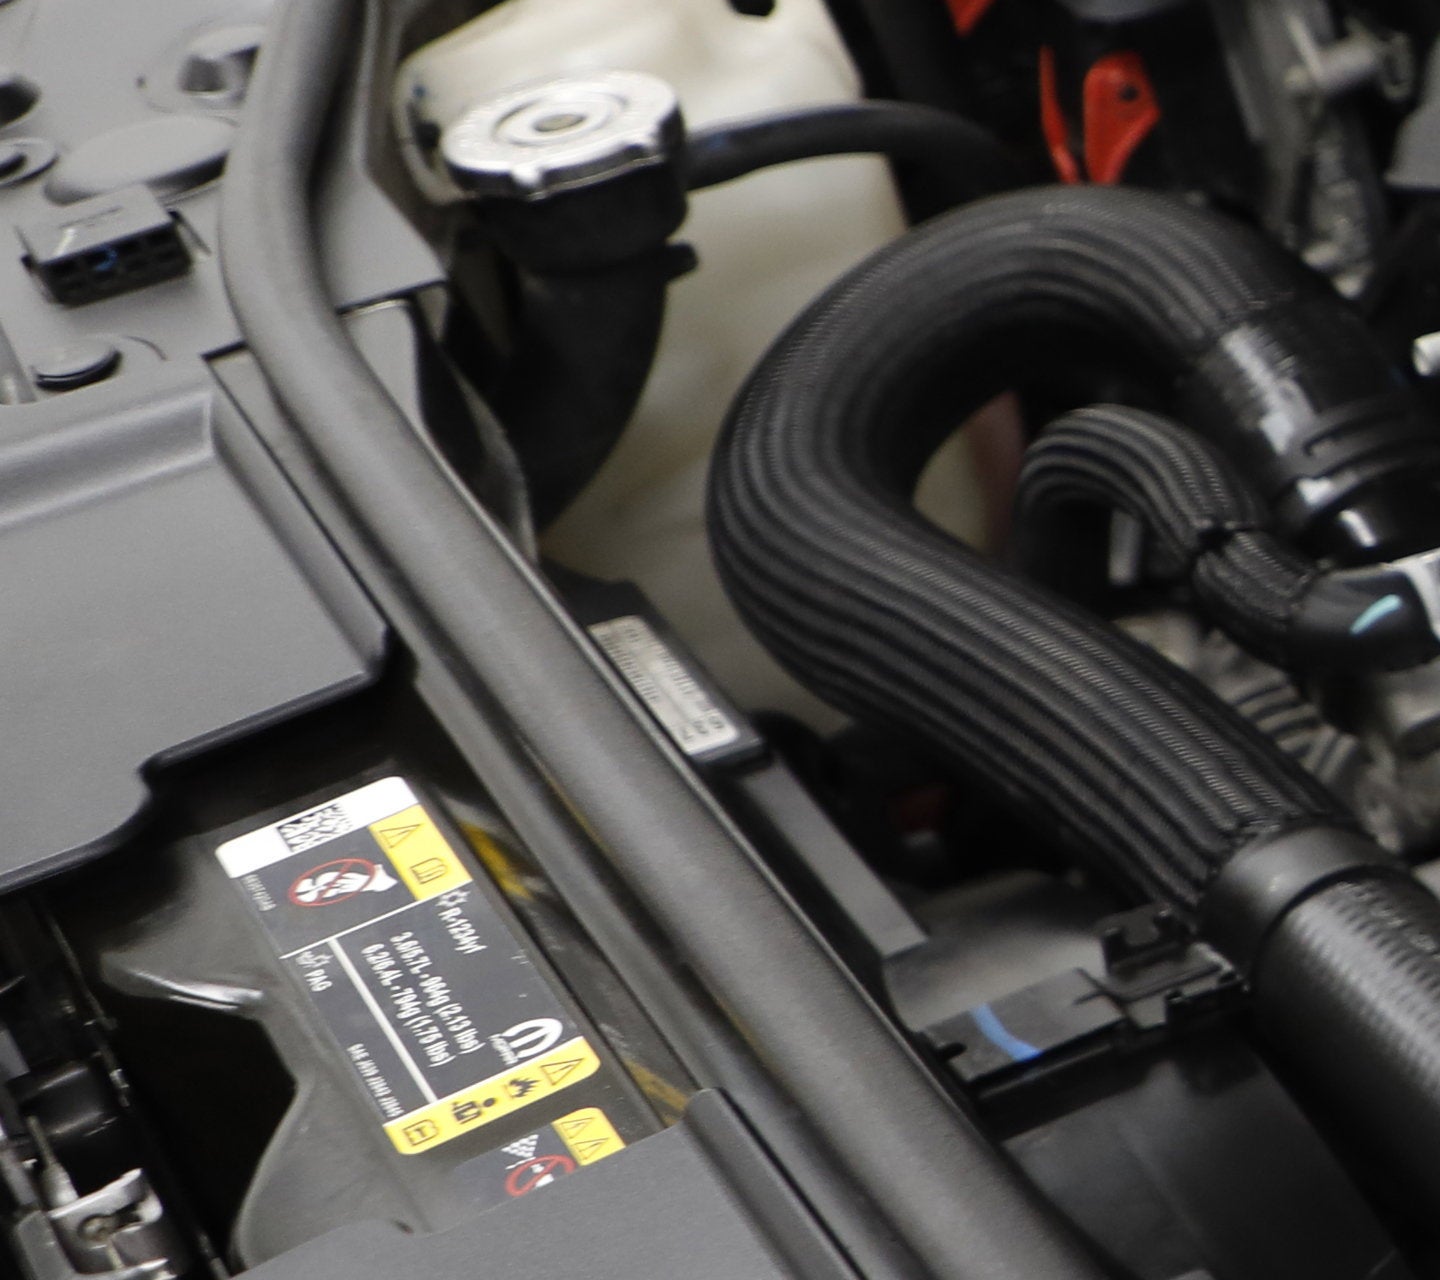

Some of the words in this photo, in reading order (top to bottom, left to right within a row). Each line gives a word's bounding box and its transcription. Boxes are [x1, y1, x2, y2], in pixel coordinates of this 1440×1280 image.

[438, 907, 488, 954] R-1234yf
[390, 931, 432, 974] 3.6/5.7L
[304, 969, 333, 992] PAG
[419, 976, 451, 1007] 964g
[361, 943, 403, 986] 6.2/6.4L
[390, 987, 422, 1019] 794g
[423, 1041, 456, 1067] lbs)
[432, 1003, 472, 1031] (2.13
[454, 1028, 486, 1054] lbs)
